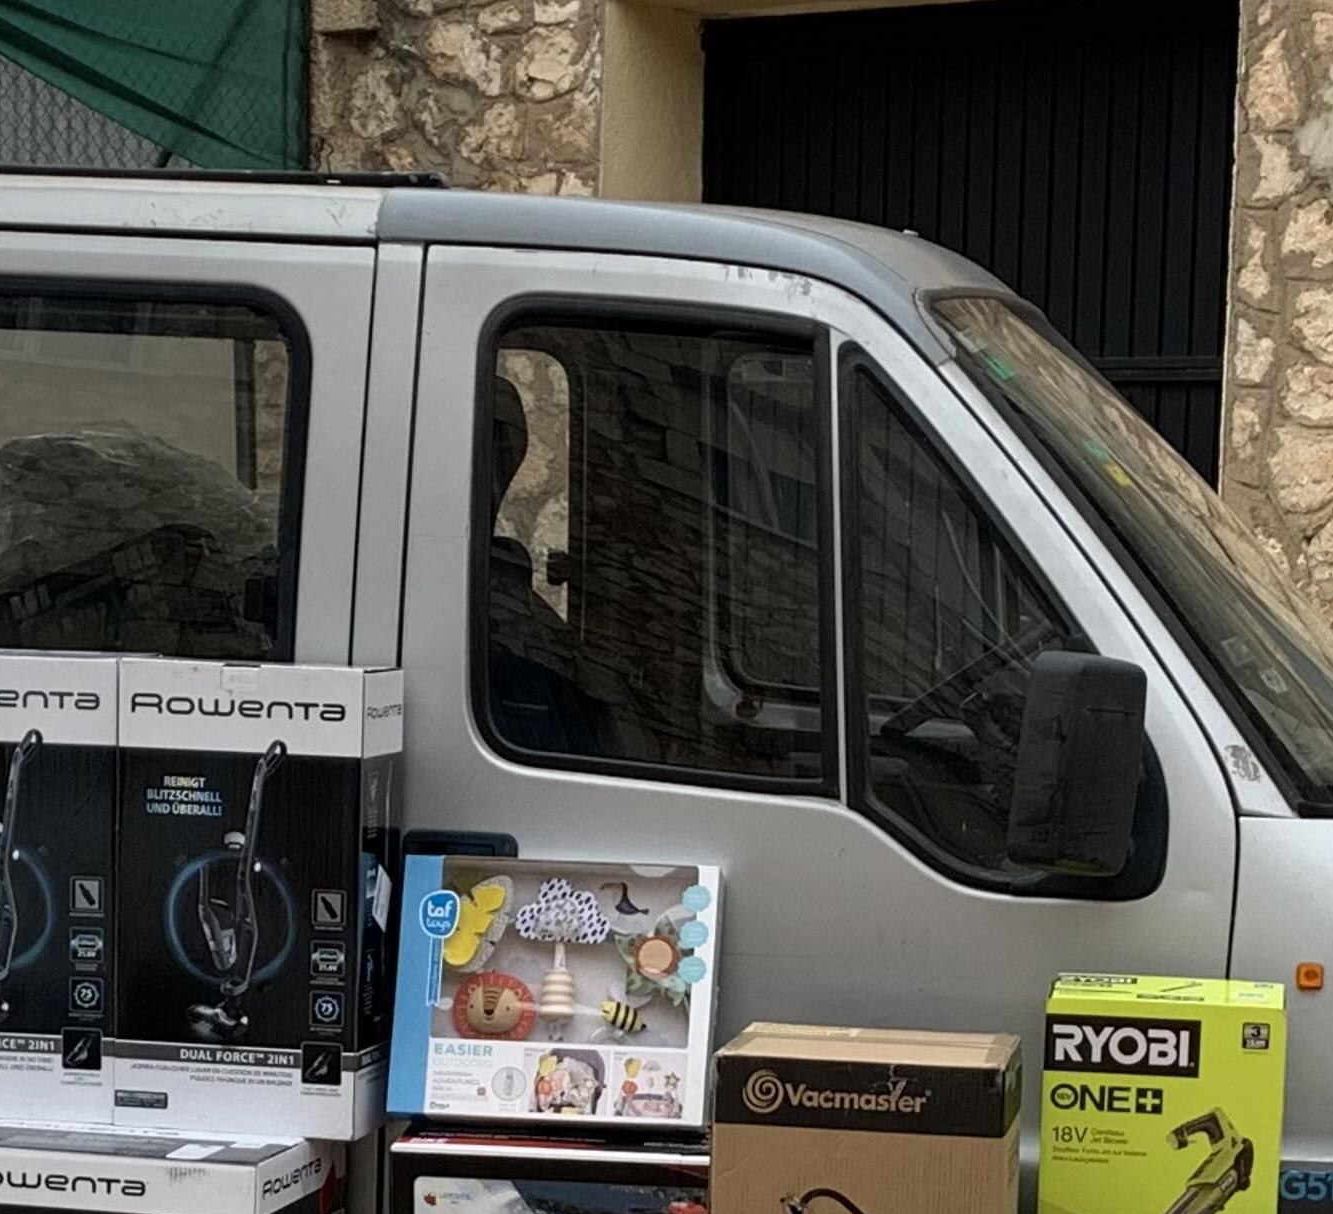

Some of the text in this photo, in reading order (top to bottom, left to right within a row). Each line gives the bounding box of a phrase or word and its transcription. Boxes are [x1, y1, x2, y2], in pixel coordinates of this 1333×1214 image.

[146, 802, 170, 813] UND
[428, 900, 453, 918] taf
[1250, 1026, 1260, 1038] 3
[28, 1040, 55, 1051] 2IN1
[434, 1043, 493, 1057] EASIER
[1052, 1023, 1191, 1067] RYOBI
[180, 1049, 213, 1061] DUAL
[267, 1053, 295, 1065] 2IN1
[785, 1082, 927, 1114] Vacmaster
[1052, 1126, 1089, 1143] 18V
